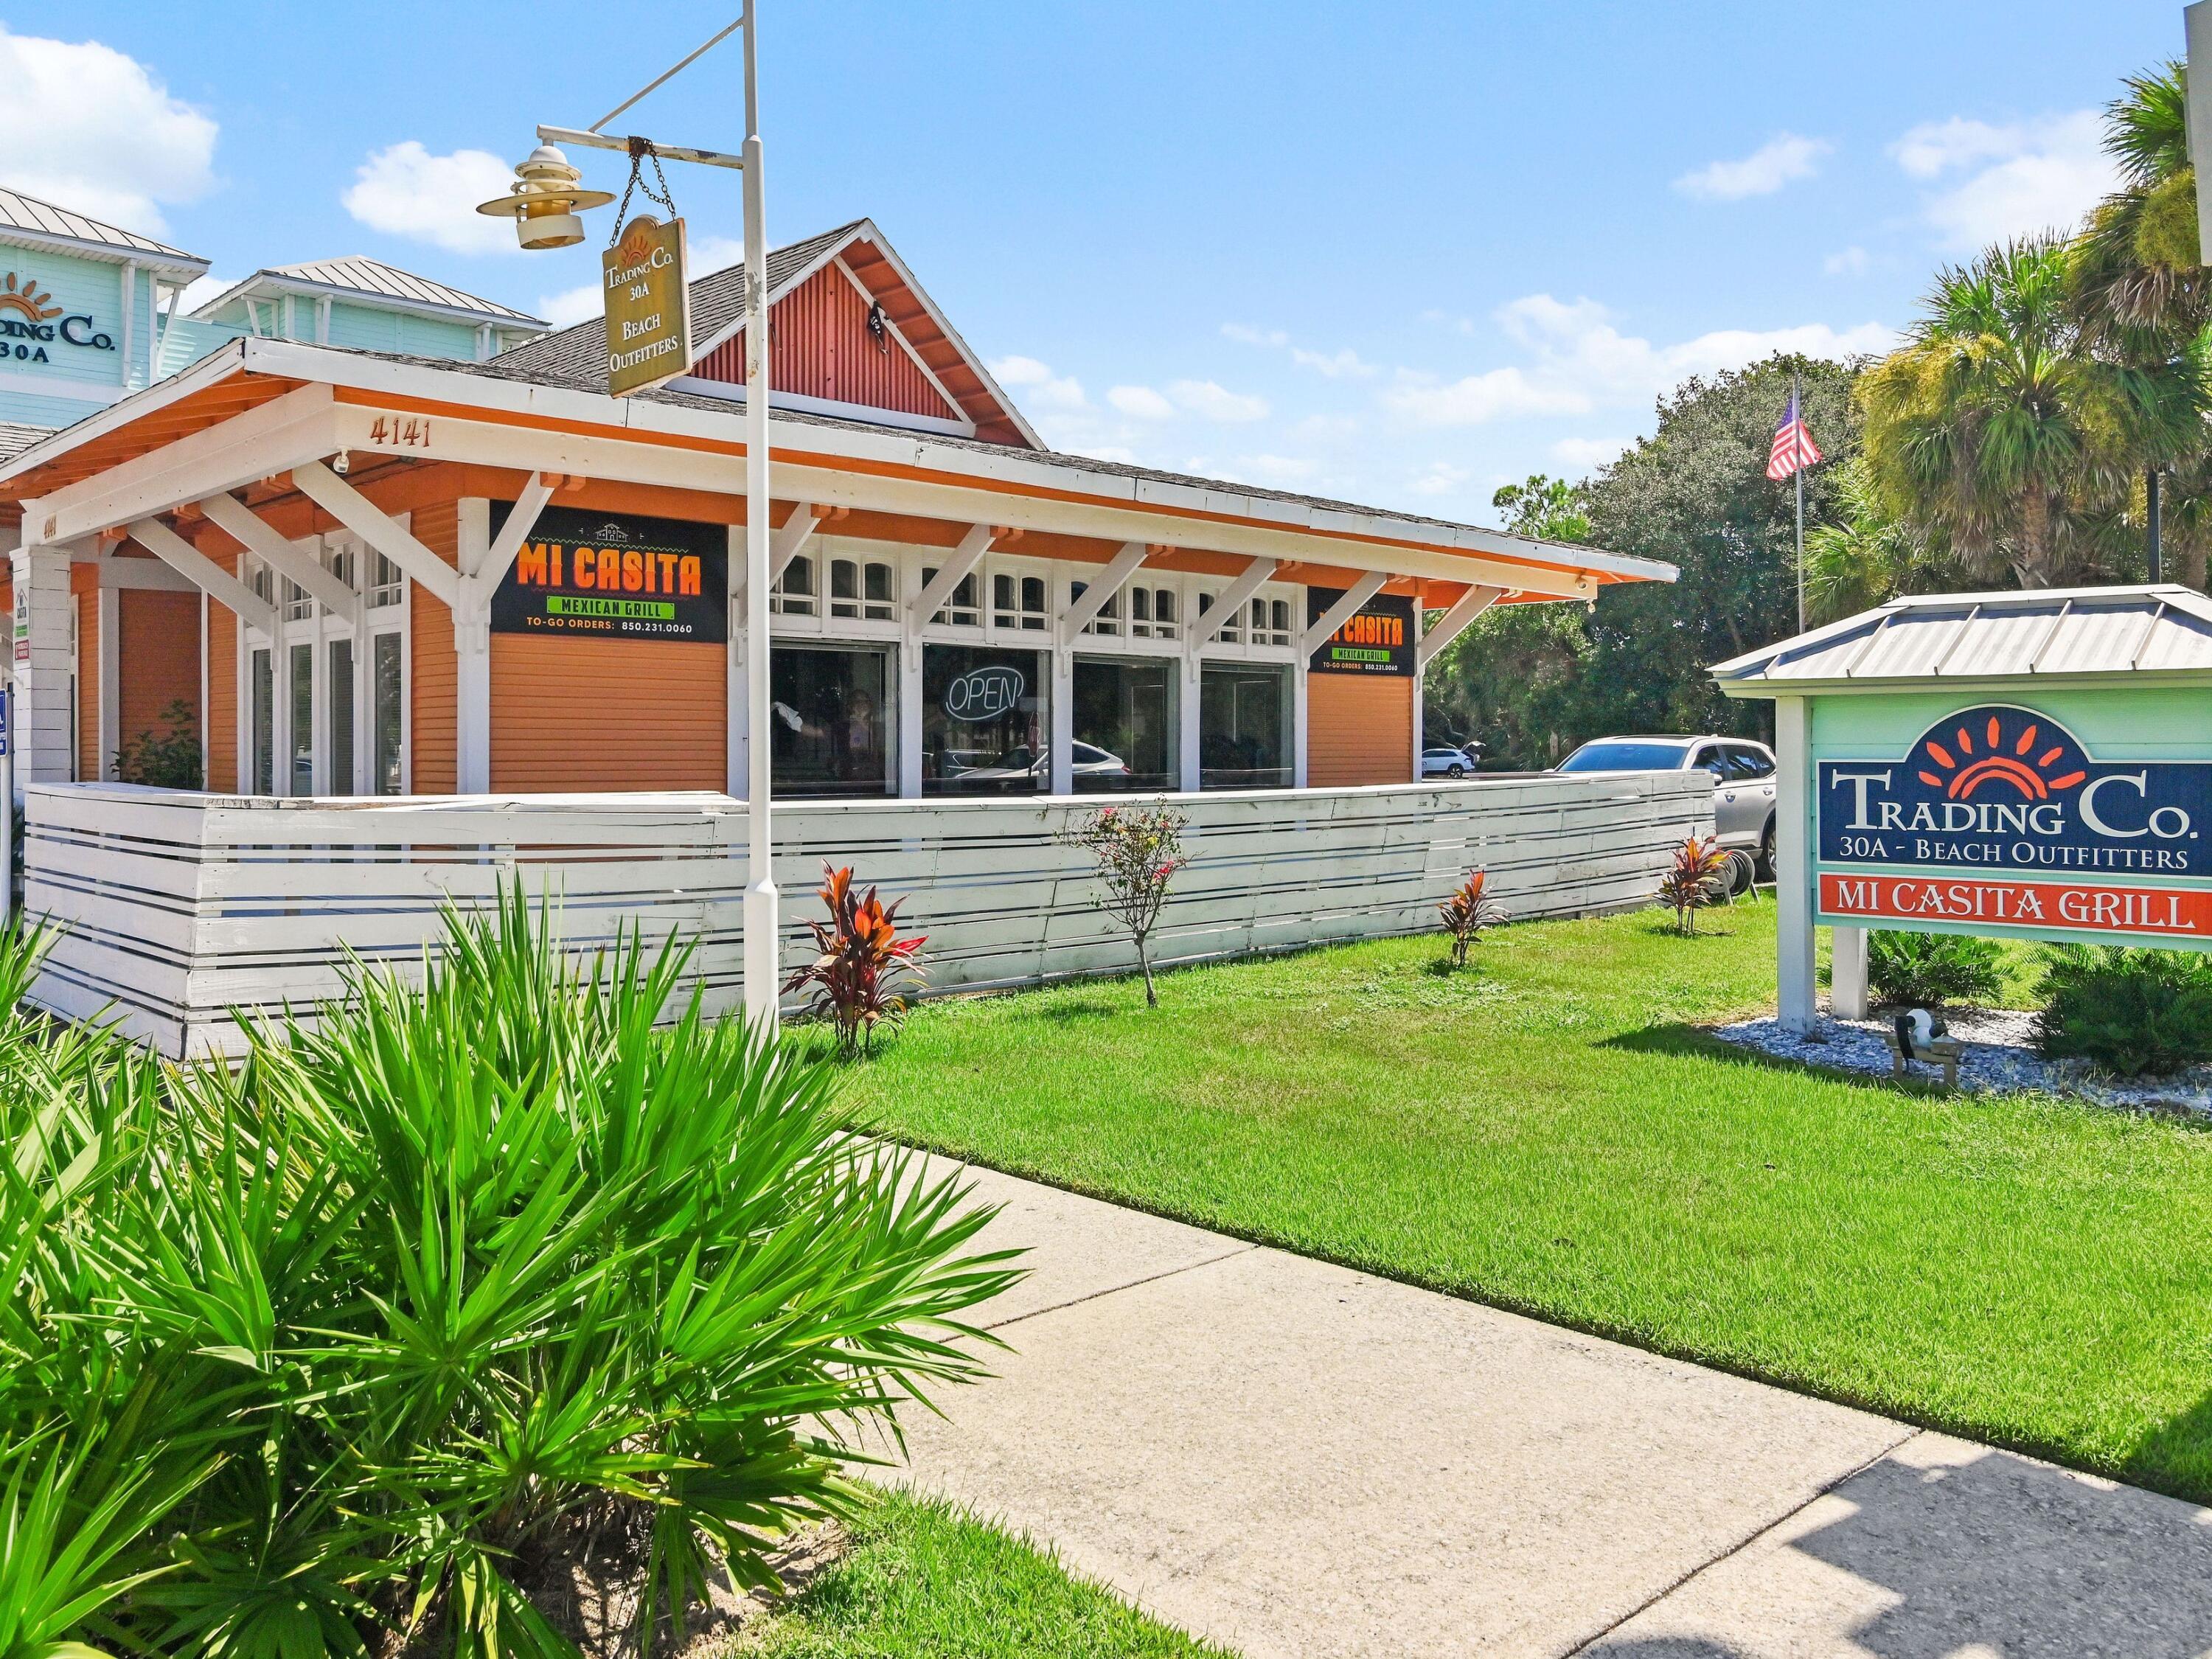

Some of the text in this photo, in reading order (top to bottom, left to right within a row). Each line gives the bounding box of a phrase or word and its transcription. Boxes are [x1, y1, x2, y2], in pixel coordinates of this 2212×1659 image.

[606, 262, 652, 289] TRADING
[630, 282, 650, 301] 30A
[622, 313, 661, 341] BEACH
[0, 341, 49, 363] 30A
[609, 335, 678, 372] OUTFITTERS
[370, 416, 430, 448] 4141
[518, 542, 700, 596] MI CASITA
[562, 599, 661, 617] MEXICAN GRILL
[526, 616, 692, 633] TO-GO ORDERS: 850.231.0060
[1344, 615, 1403, 646] CASITA
[1338, 649, 1383, 661] MEXICAN GRILL
[1341, 662, 1363, 670] ORDERS:
[949, 677, 1018, 710] OPEN
[1832, 769, 2066, 836] TRADING
[1840, 836, 1889, 858] 30A
[1915, 838, 2002, 863] BEACH
[2012, 841, 2188, 870] OUTFITTERS
[1837, 880, 2197, 928] MI CASITA GRILL
